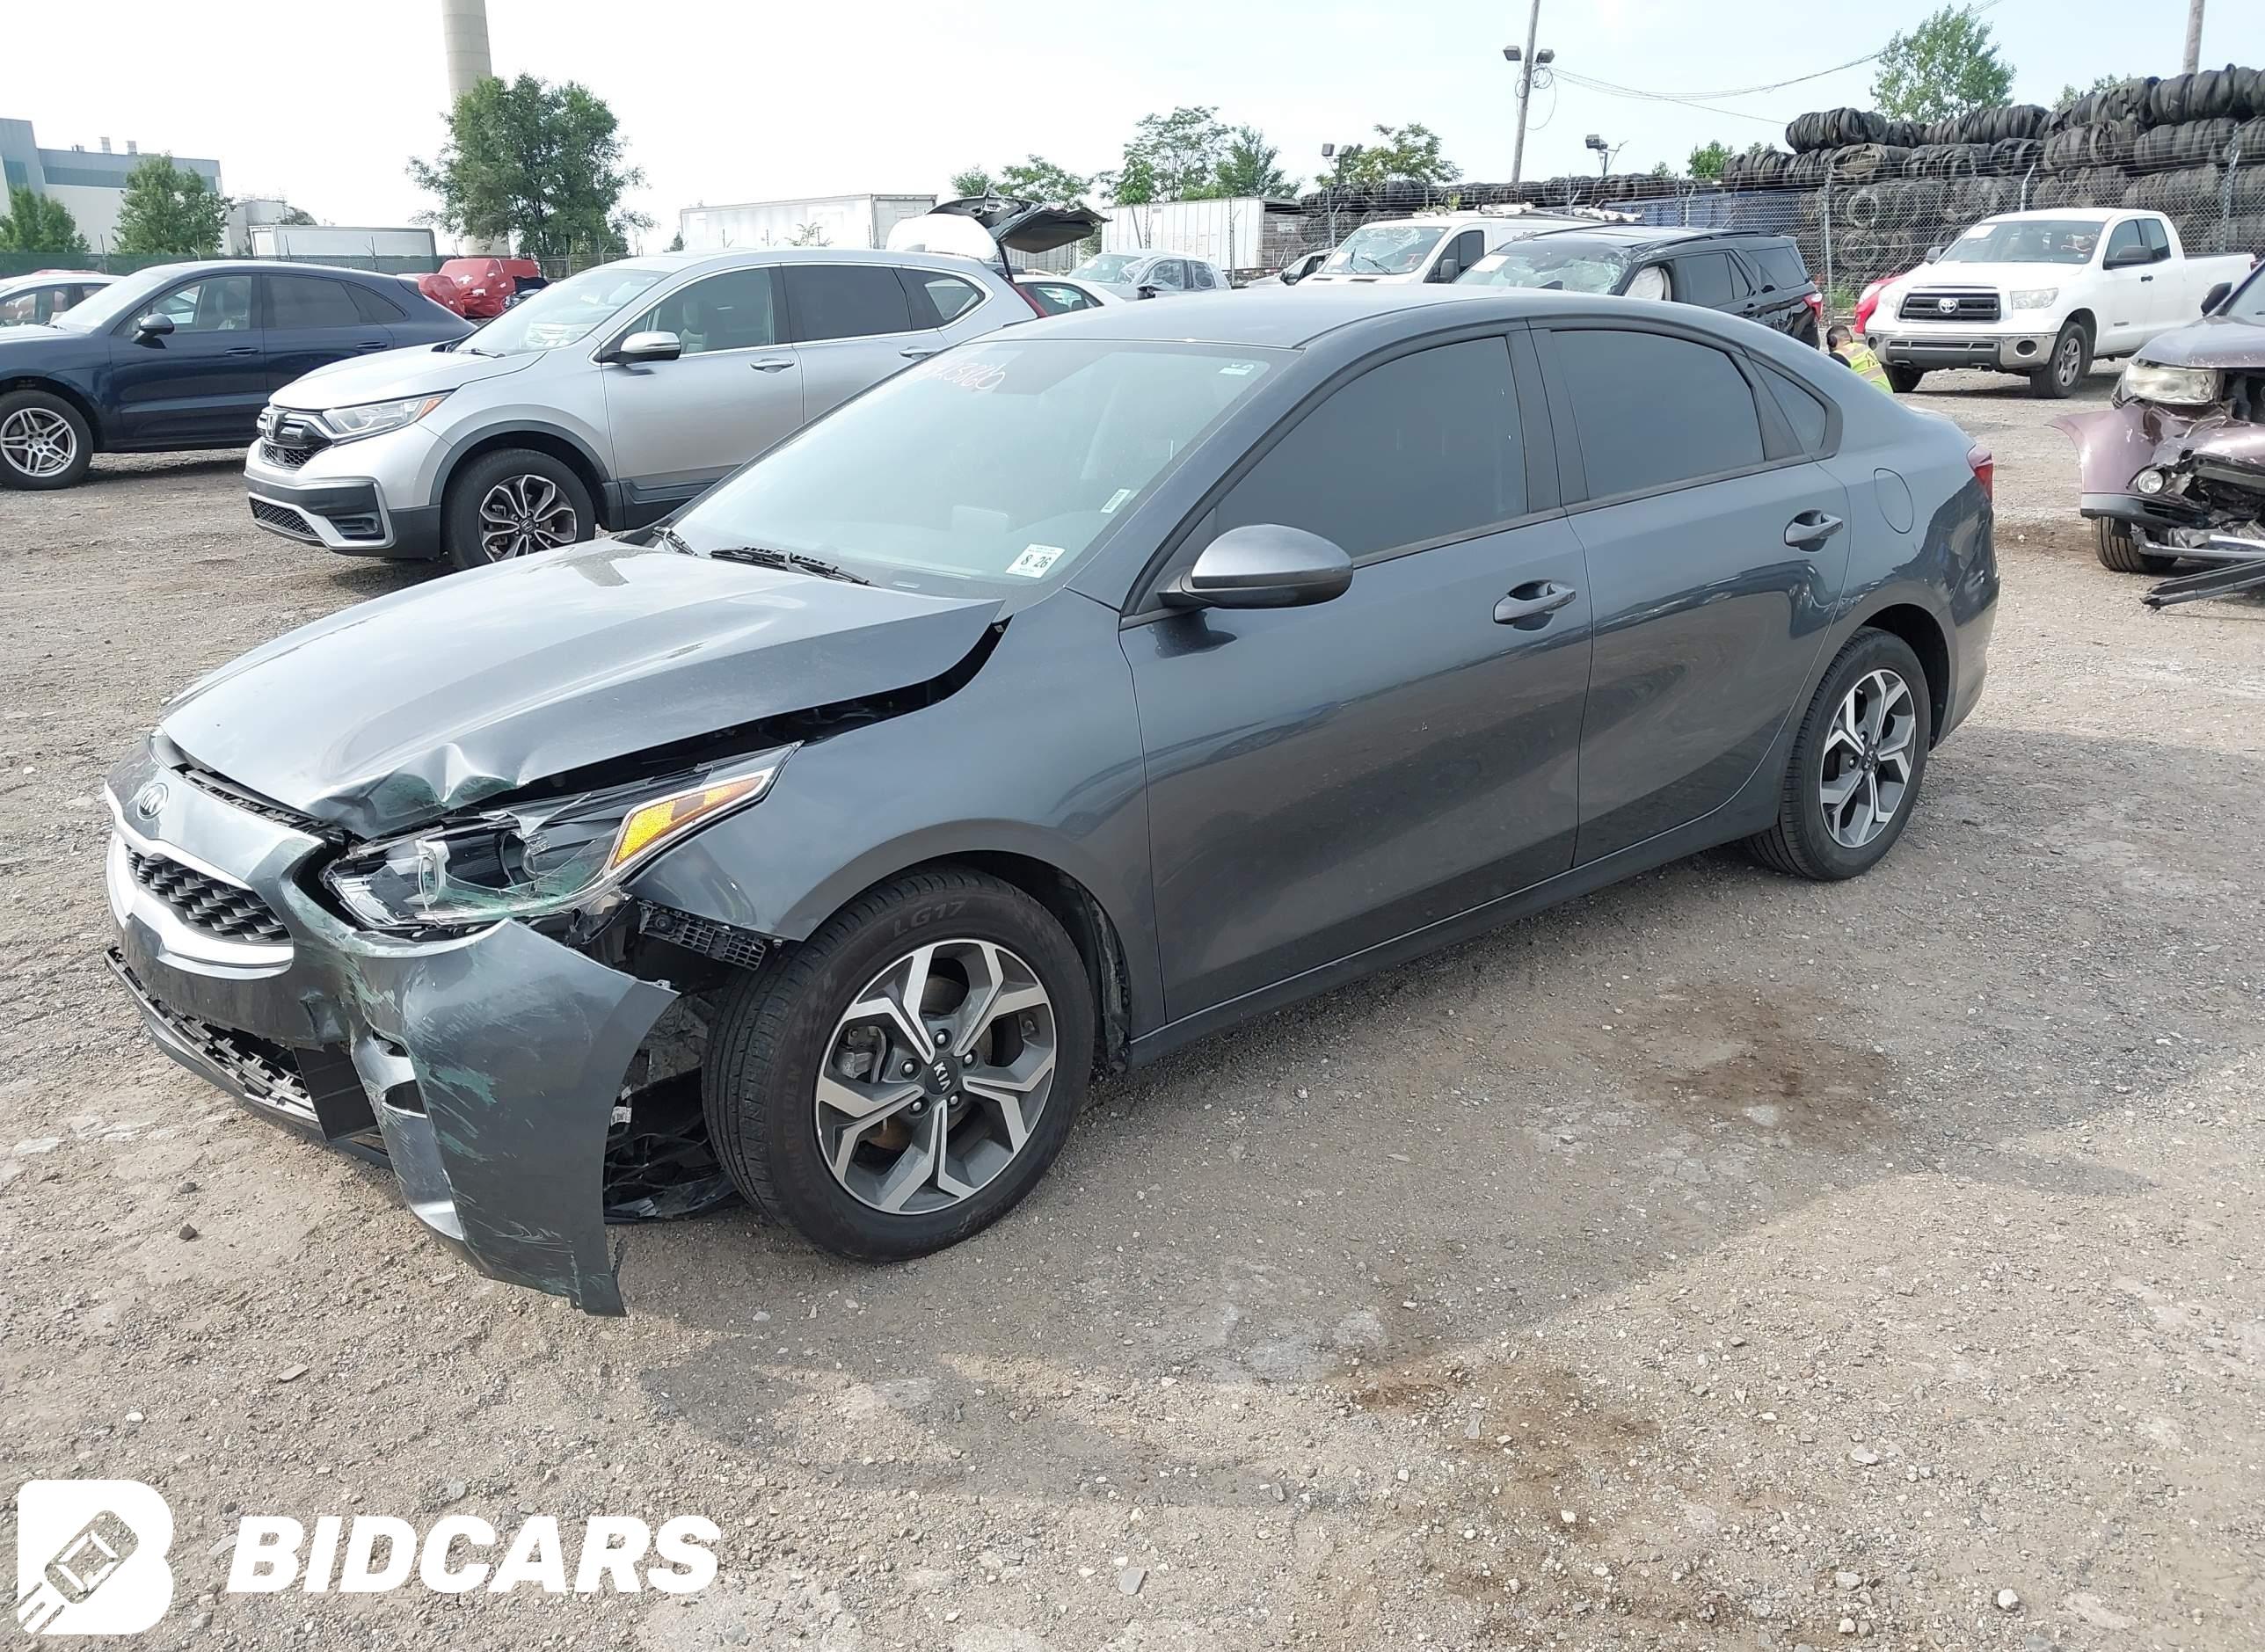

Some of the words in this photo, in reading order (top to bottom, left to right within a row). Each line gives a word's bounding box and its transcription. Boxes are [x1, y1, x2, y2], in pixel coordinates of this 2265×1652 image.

[1033, 556, 1052, 568] 26
[1864, 750, 1874, 768] KIA
[894, 899, 966, 937] LG17
[933, 1061, 951, 1092] KIA
